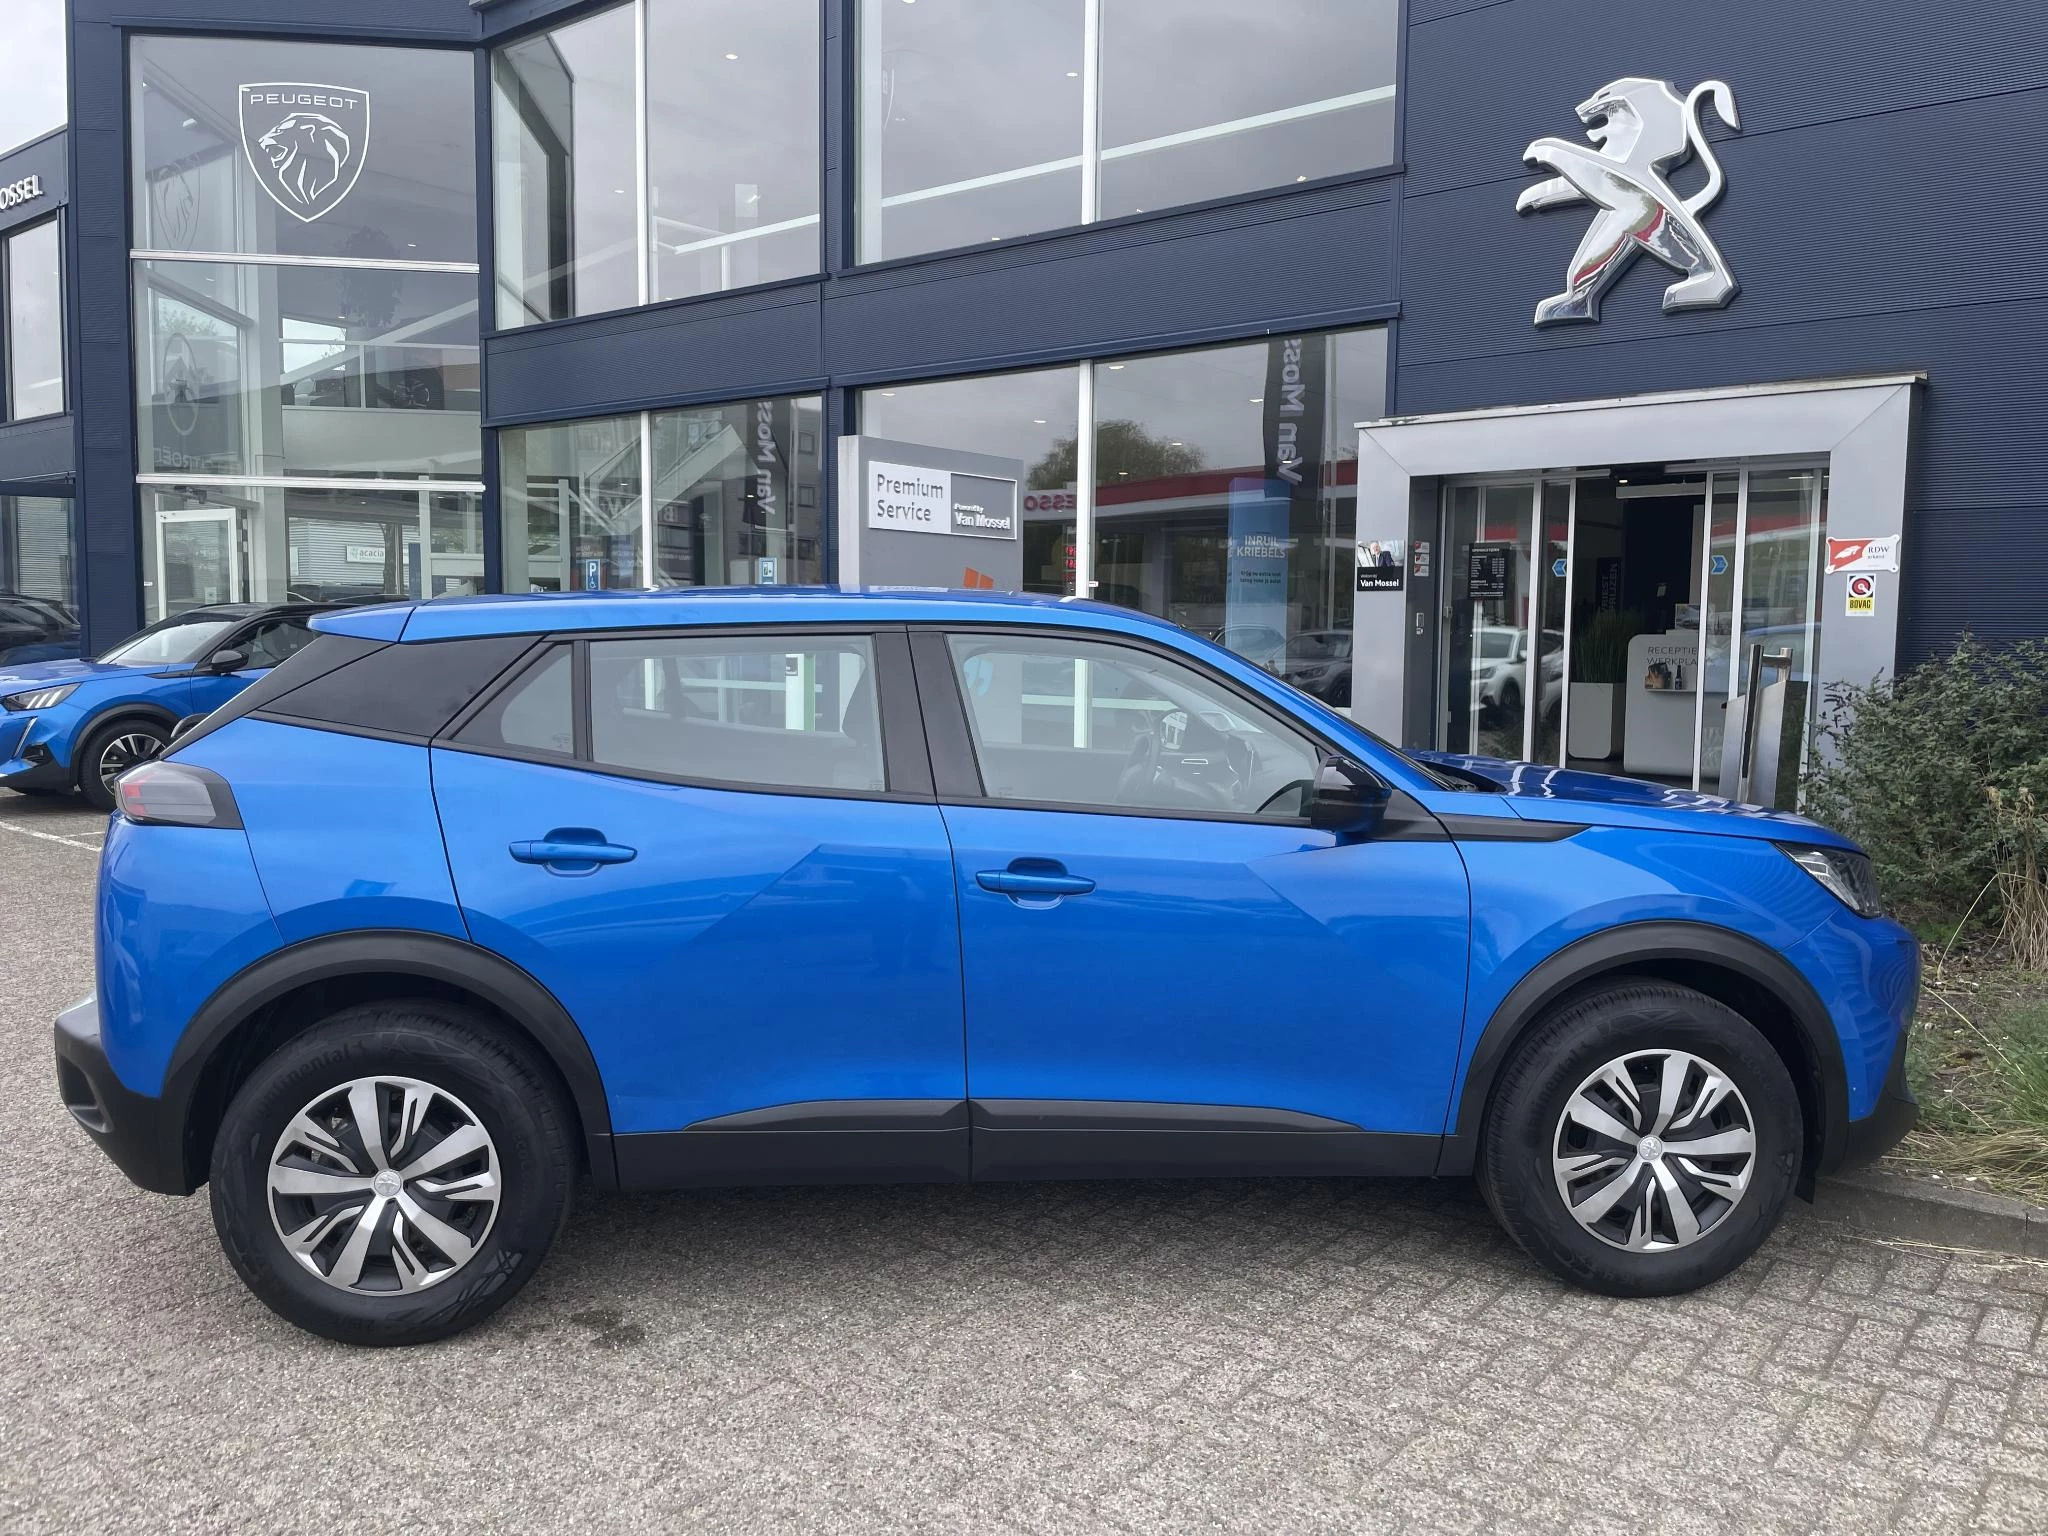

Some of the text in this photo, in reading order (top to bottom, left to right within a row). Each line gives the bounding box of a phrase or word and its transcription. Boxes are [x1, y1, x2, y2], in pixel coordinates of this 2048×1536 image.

[250, 93, 359, 110] PEUGEOT
[877, 473, 943, 499] Premium
[877, 499, 931, 522] Service
[955, 511, 1011, 530] Van Mossel
[1244, 535, 1279, 547] INRUIL
[360, 543, 385, 557] acacia
[1236, 546, 1286, 558] KRIEBELS
[1868, 546, 1889, 554] RDW
[589, 562, 597, 576] P
[1360, 579, 1400, 587] Van Mossel
[1647, 646, 1697, 655] RECEPTIE
[242, 1043, 352, 1127] ntinental
